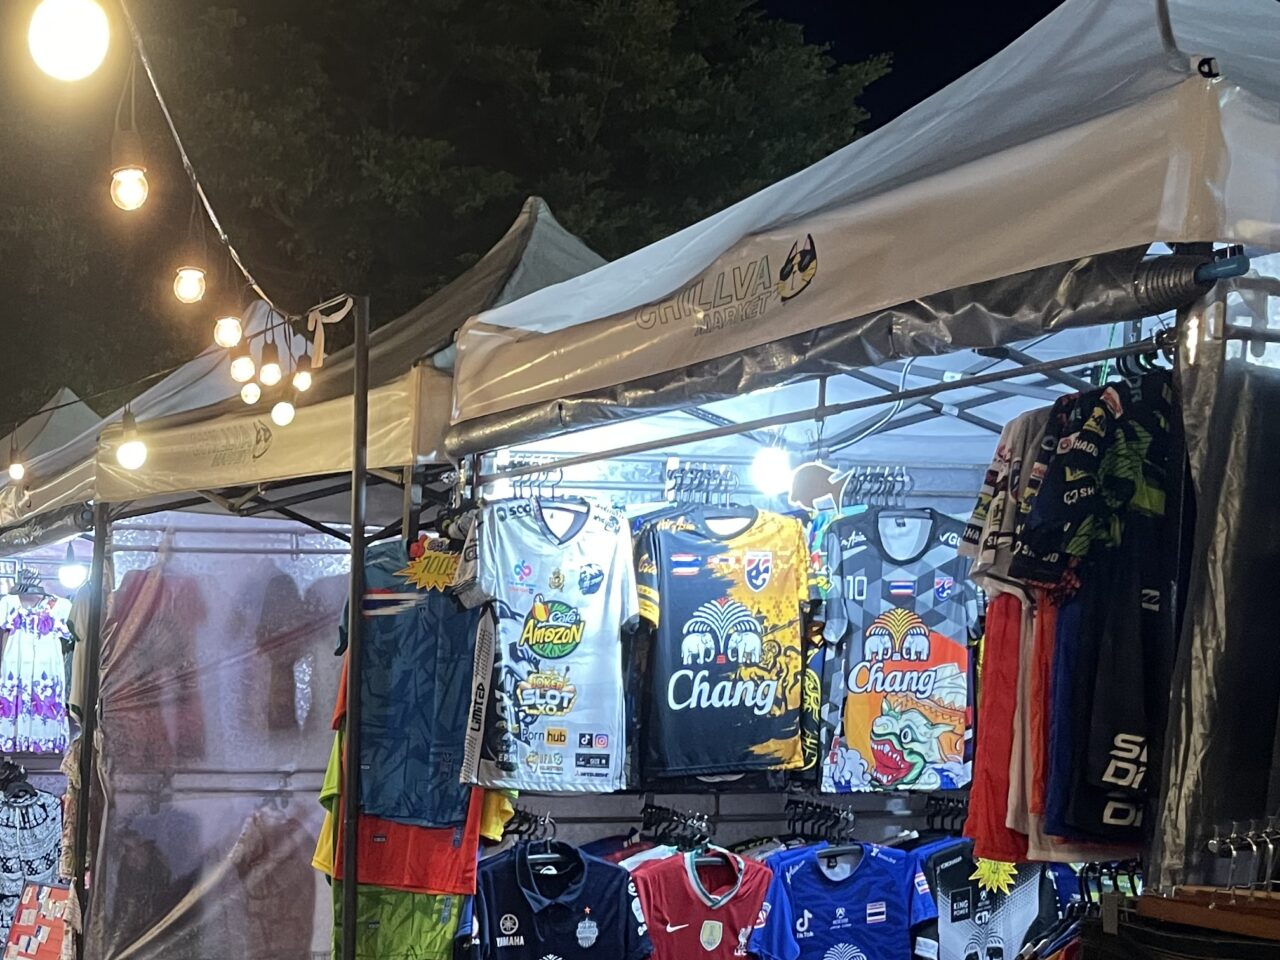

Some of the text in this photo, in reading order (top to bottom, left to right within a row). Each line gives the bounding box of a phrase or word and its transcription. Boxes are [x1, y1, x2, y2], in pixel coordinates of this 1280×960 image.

[635, 254, 772, 330] CHILLVA
[694, 292, 772, 336] MARKET
[846, 575, 867, 600] 10
[668, 669, 778, 715] Chang
[848, 660, 937, 699] Chang
[522, 688, 574, 707] SLOT
[536, 704, 557, 715] XO
[522, 728, 566, 743] Porn hub
